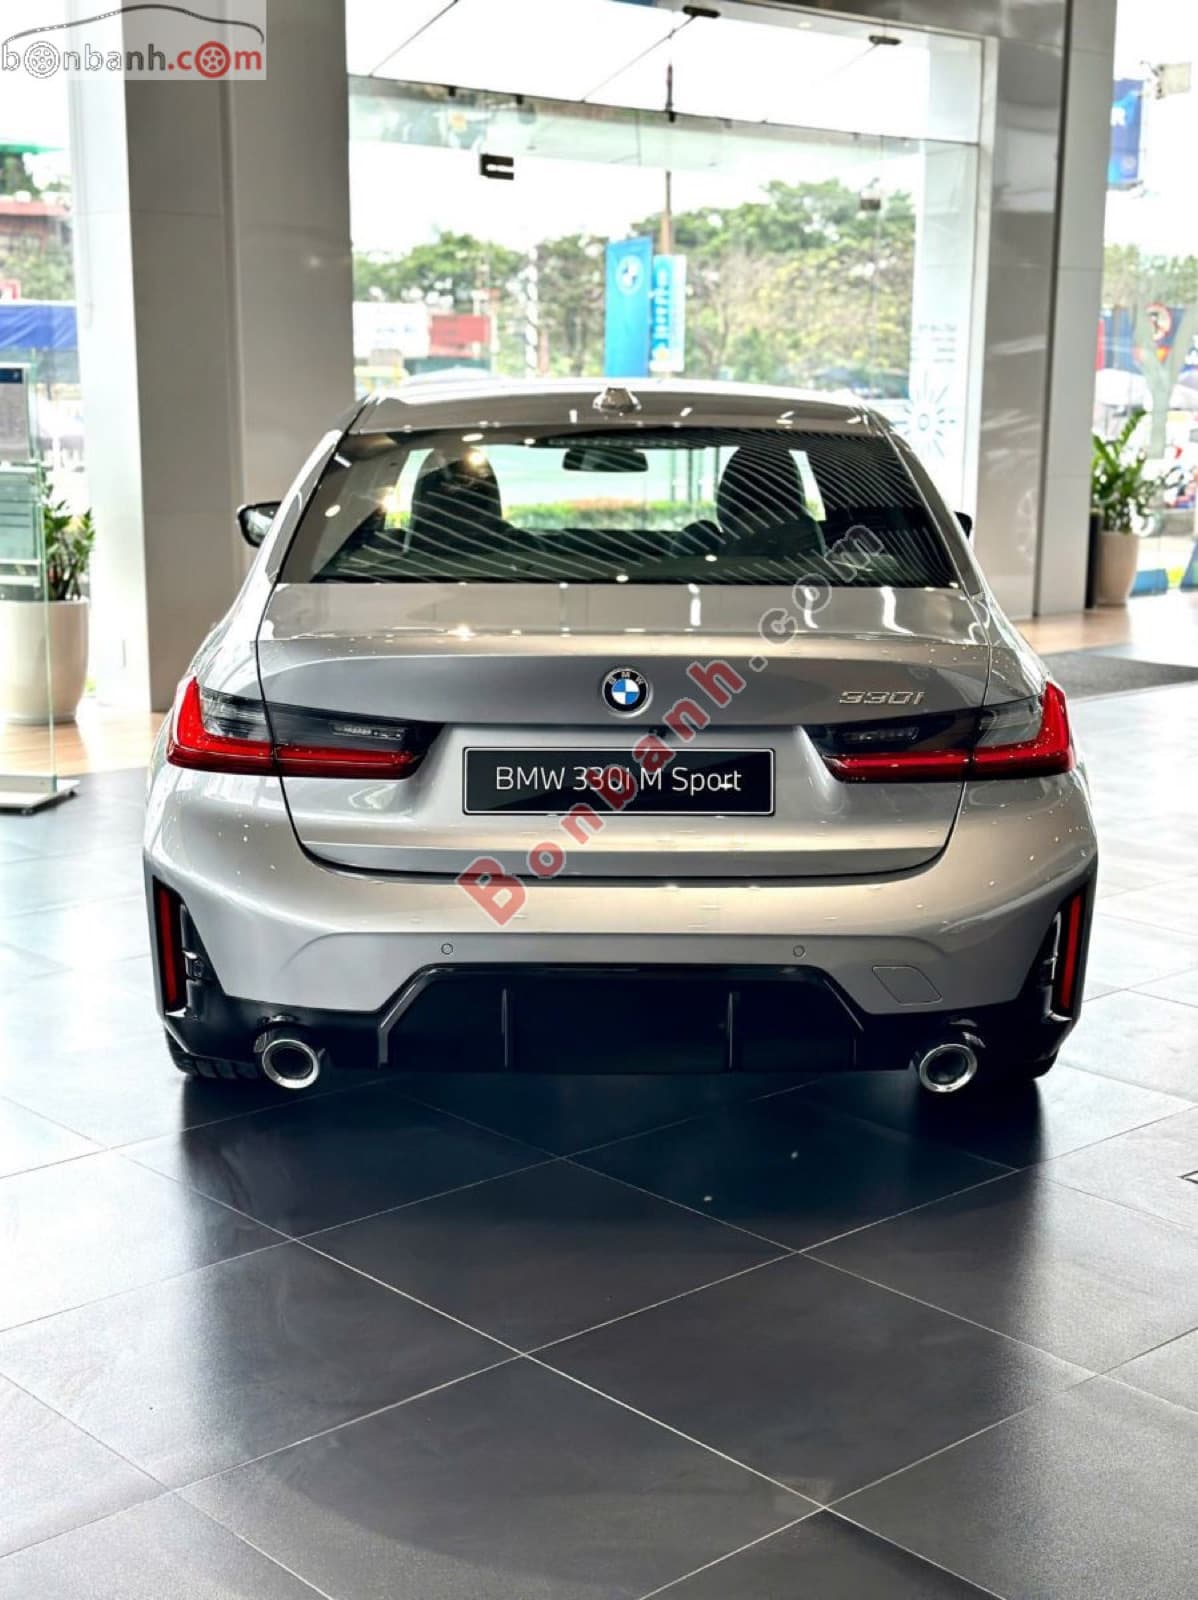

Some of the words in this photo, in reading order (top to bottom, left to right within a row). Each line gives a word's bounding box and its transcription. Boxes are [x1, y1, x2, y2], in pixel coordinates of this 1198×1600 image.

[495, 766, 565, 791] BMW
[640, 766, 662, 791] M
[671, 767, 742, 797] Sport
